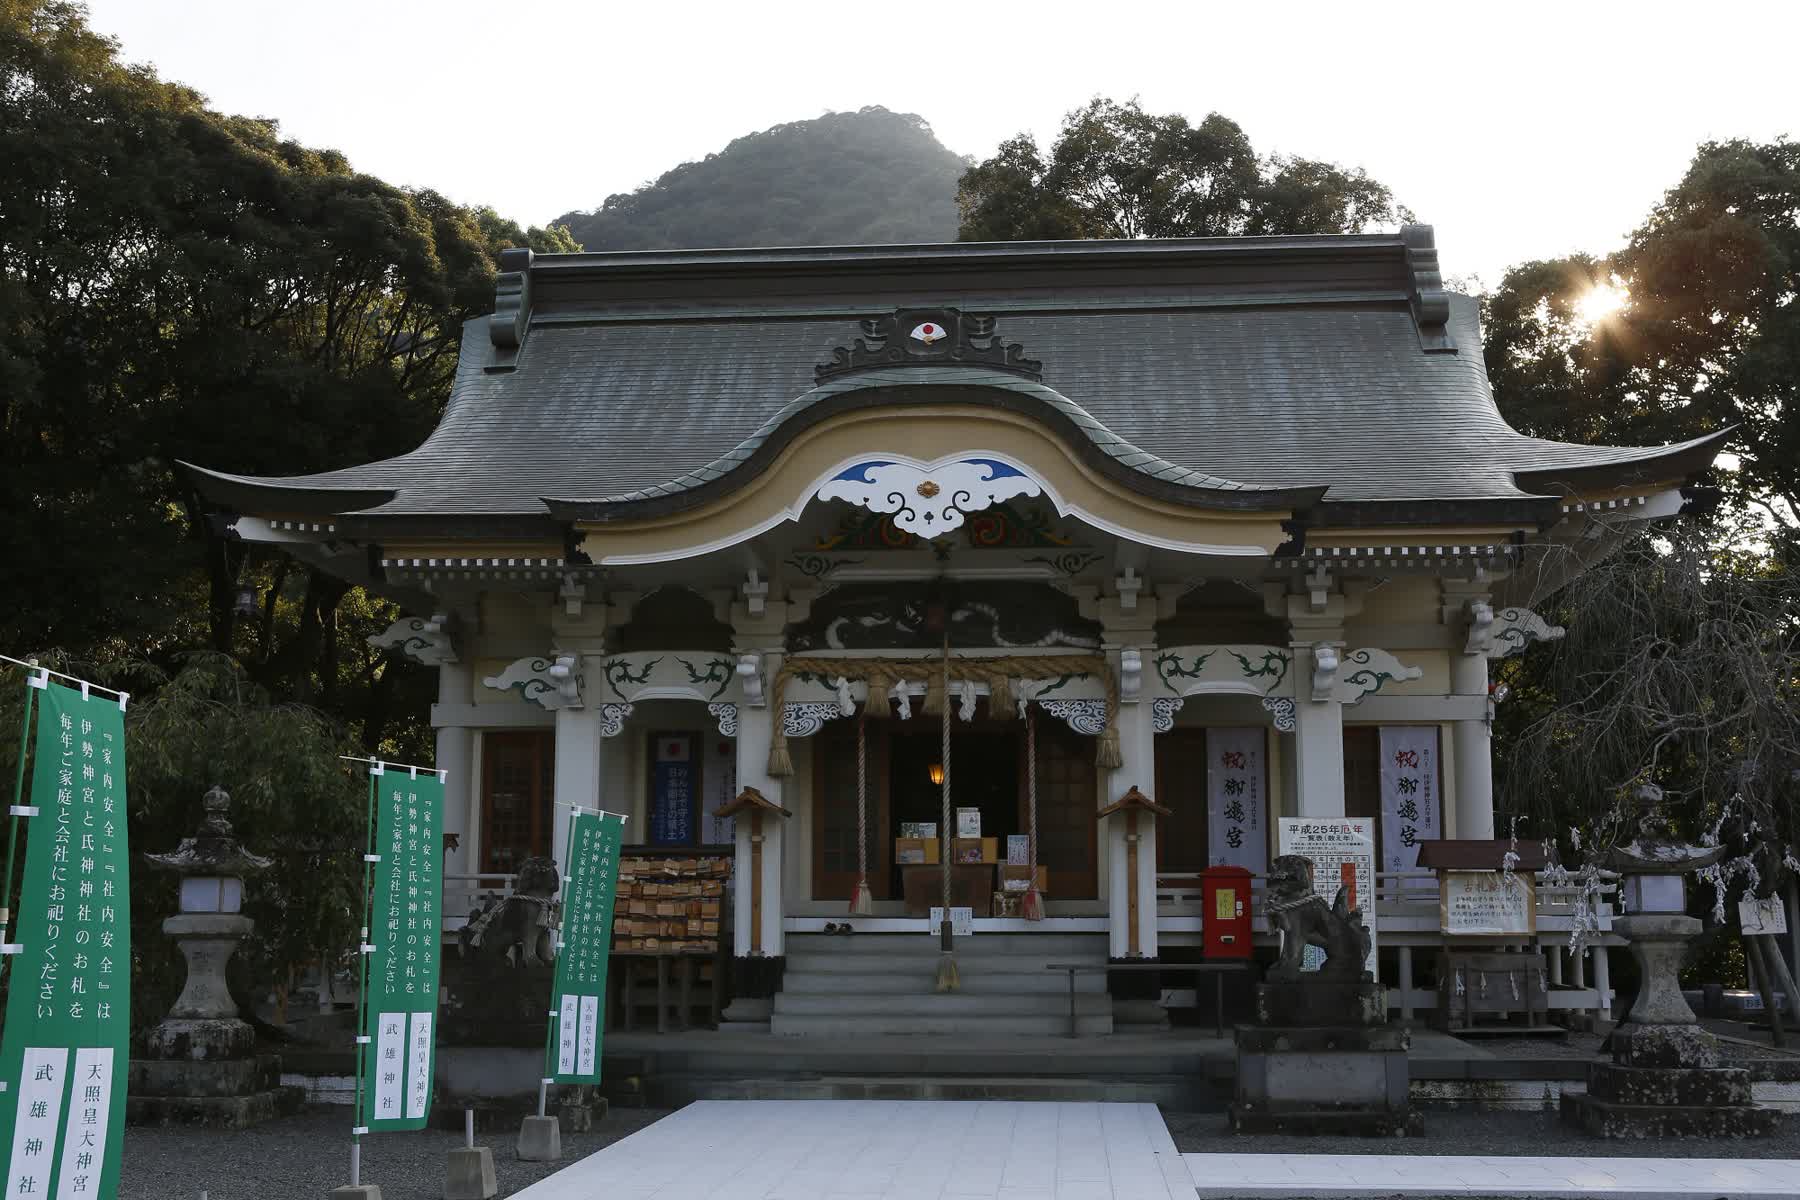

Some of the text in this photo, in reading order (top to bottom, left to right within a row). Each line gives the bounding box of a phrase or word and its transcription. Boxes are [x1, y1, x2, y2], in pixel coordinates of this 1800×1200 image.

[37, 712, 73, 1019] 毎年ご家庭と会社にお祀りください
[69, 719, 95, 1019] 伊勢神宮と氏神神社のお札を
[97, 732, 115, 1019] 『家内安全』『社内安全』は
[384, 790, 402, 994] 毎年ご家庭と会社にお祀りください
[405, 792, 417, 994] 伊勢神宮と氏神神社のお札を
[423, 800, 432, 993] 『家内安全』『社内安全』は
[1288, 824, 1364, 834] 平成25年厄年
[18, 1063, 54, 1193] 武雄神社
[73, 1063, 102, 1192] 天照皇大神宮
[383, 1023, 398, 1109] 武雄神社
[416, 1022, 427, 1107] 天照皇大神宮
